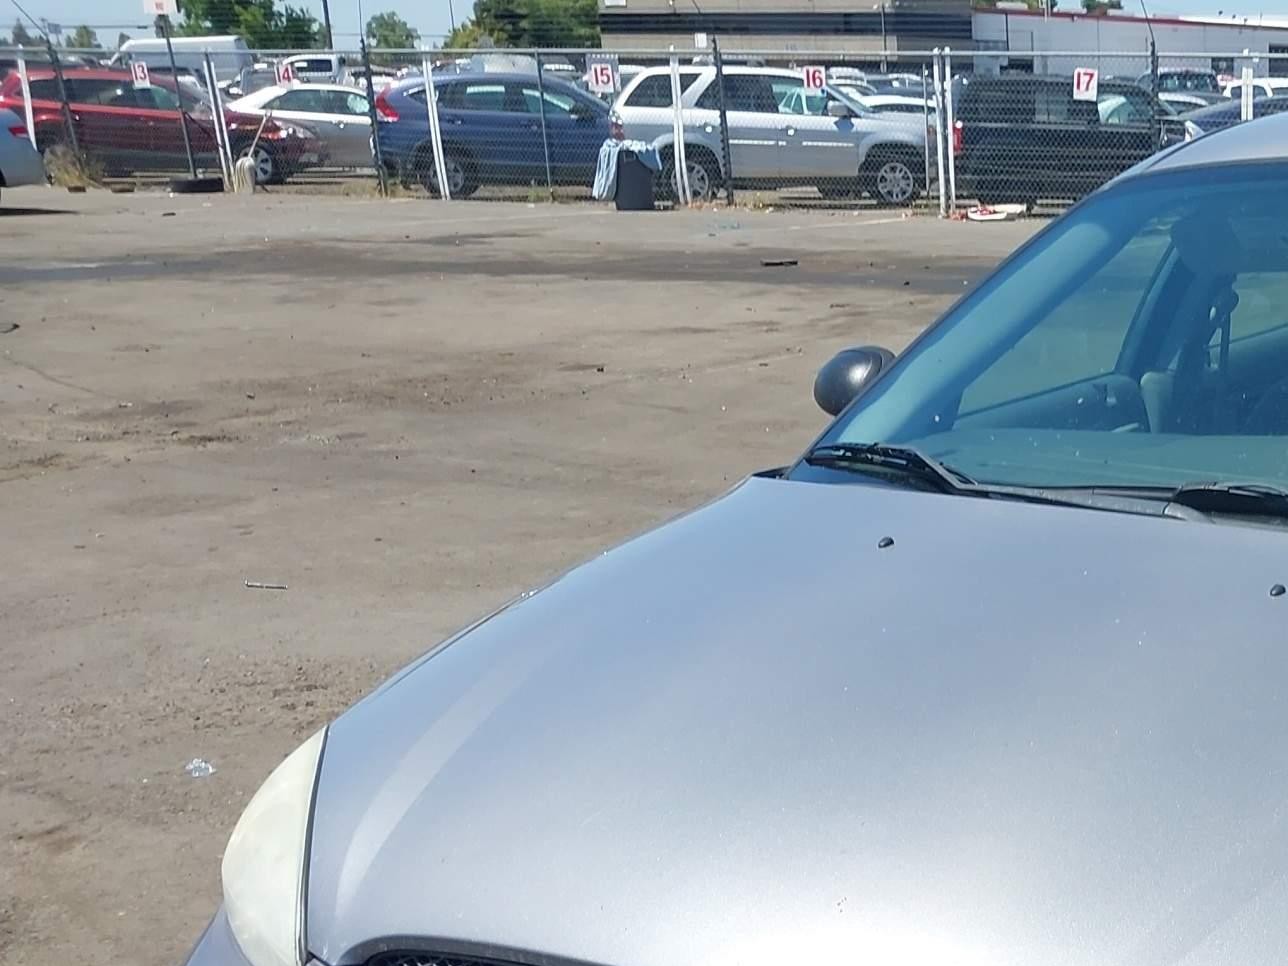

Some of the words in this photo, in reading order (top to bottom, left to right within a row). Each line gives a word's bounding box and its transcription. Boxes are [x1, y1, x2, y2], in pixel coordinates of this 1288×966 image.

[133, 64, 147, 81] 13
[276, 64, 291, 84] 14
[593, 66, 611, 86] 15
[805, 68, 824, 89] 16
[1076, 72, 1095, 92] 17
